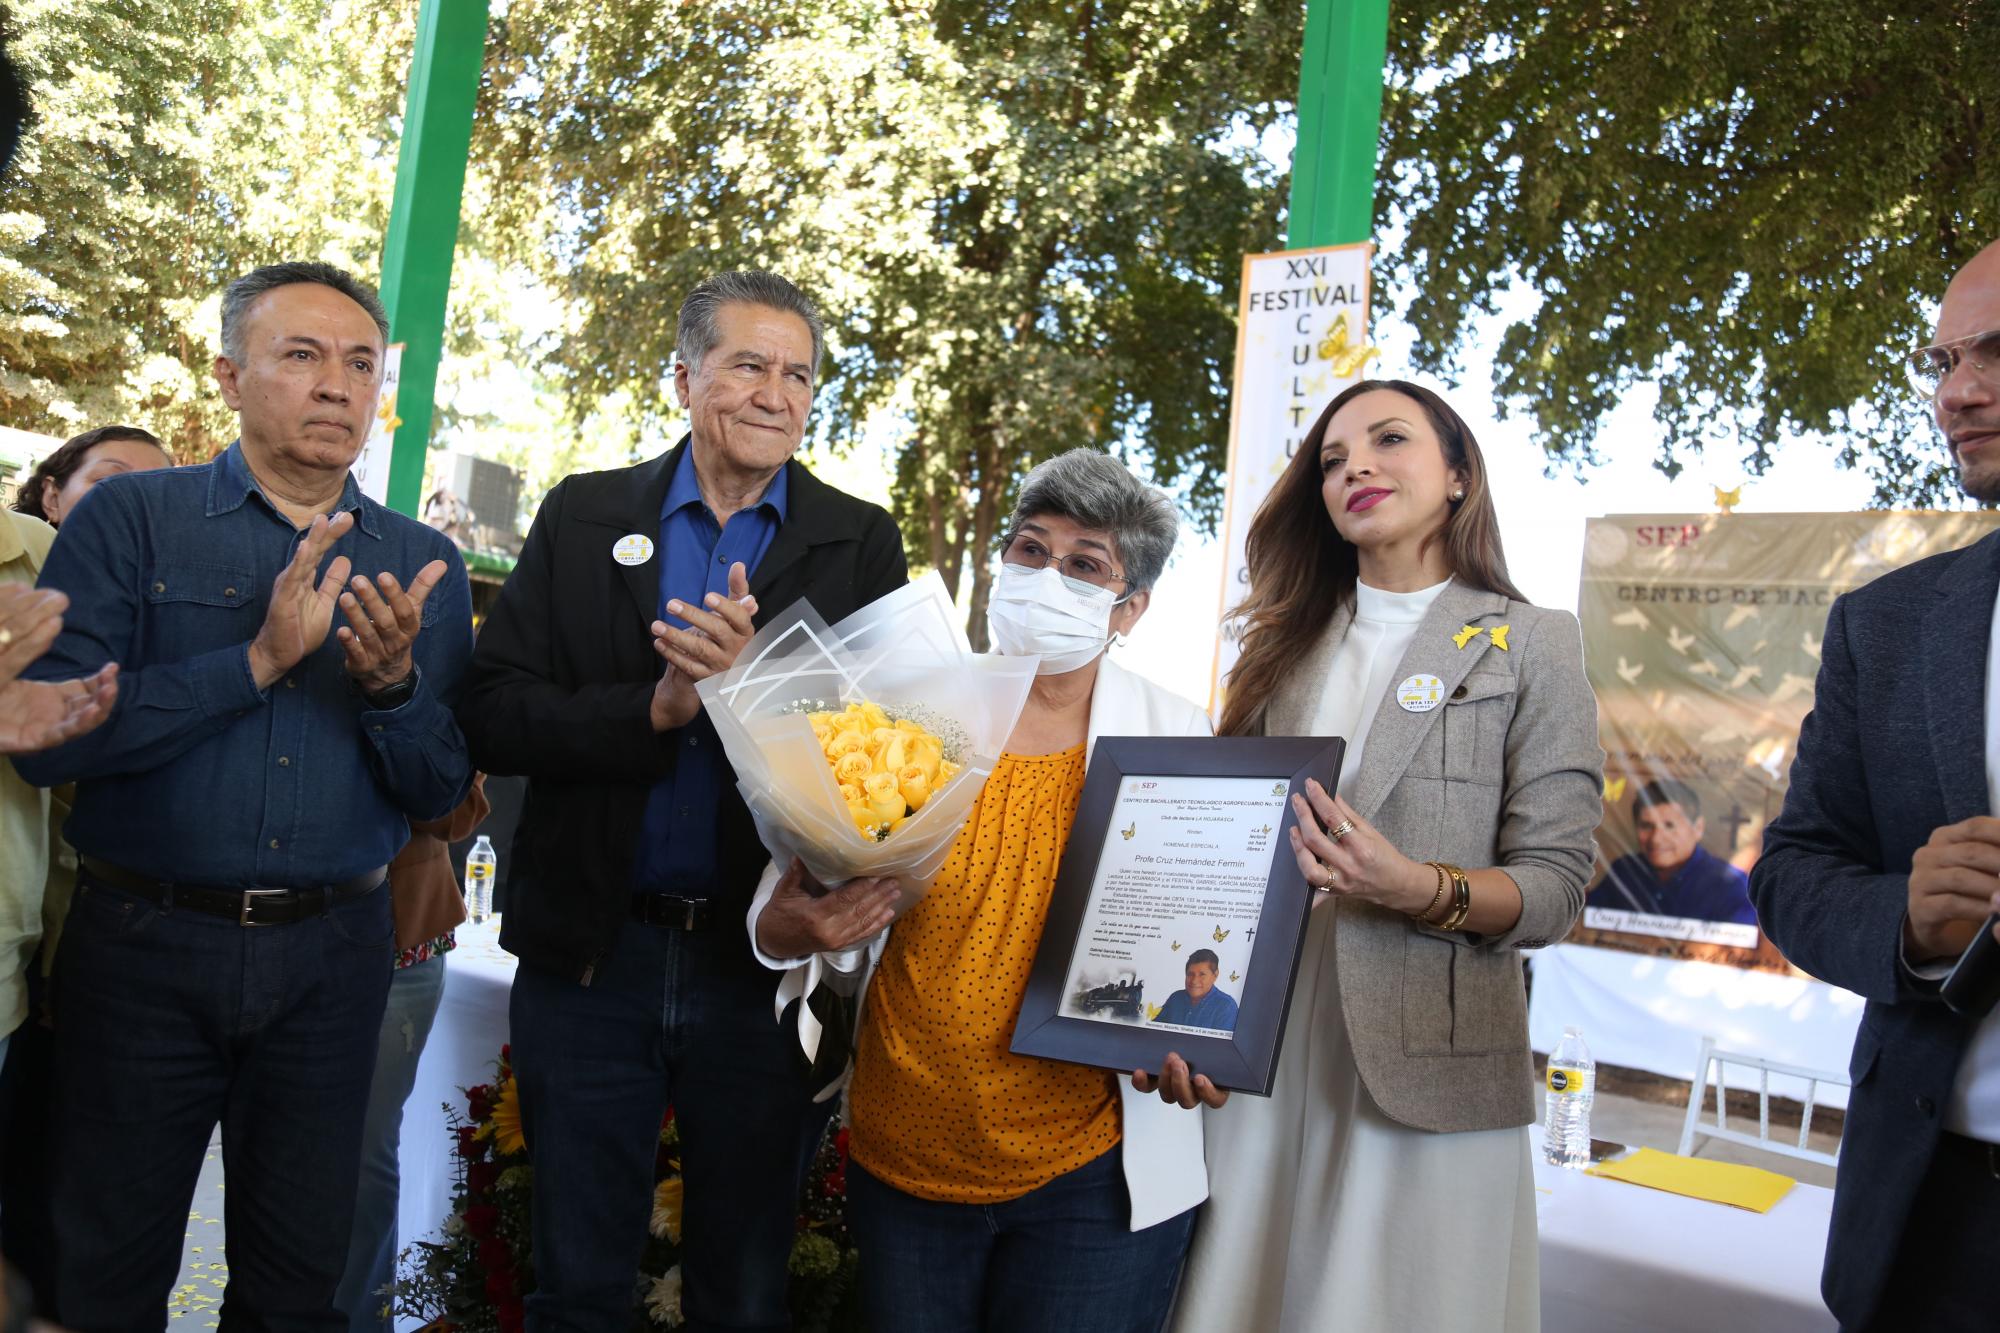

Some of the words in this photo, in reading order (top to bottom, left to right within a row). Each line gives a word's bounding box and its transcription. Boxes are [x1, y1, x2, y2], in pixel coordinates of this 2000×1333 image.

[1287, 256, 1327, 280] XXI
[1249, 284, 1361, 312] FESTIVAL
[1636, 525, 1700, 548] SEP
[1617, 586, 1722, 604] CENTRO
[1732, 588, 1766, 605] DE
[1134, 854, 1155, 863] Profe
[1156, 856, 1174, 864] Cruz
[1175, 857, 1216, 866] Hernández
